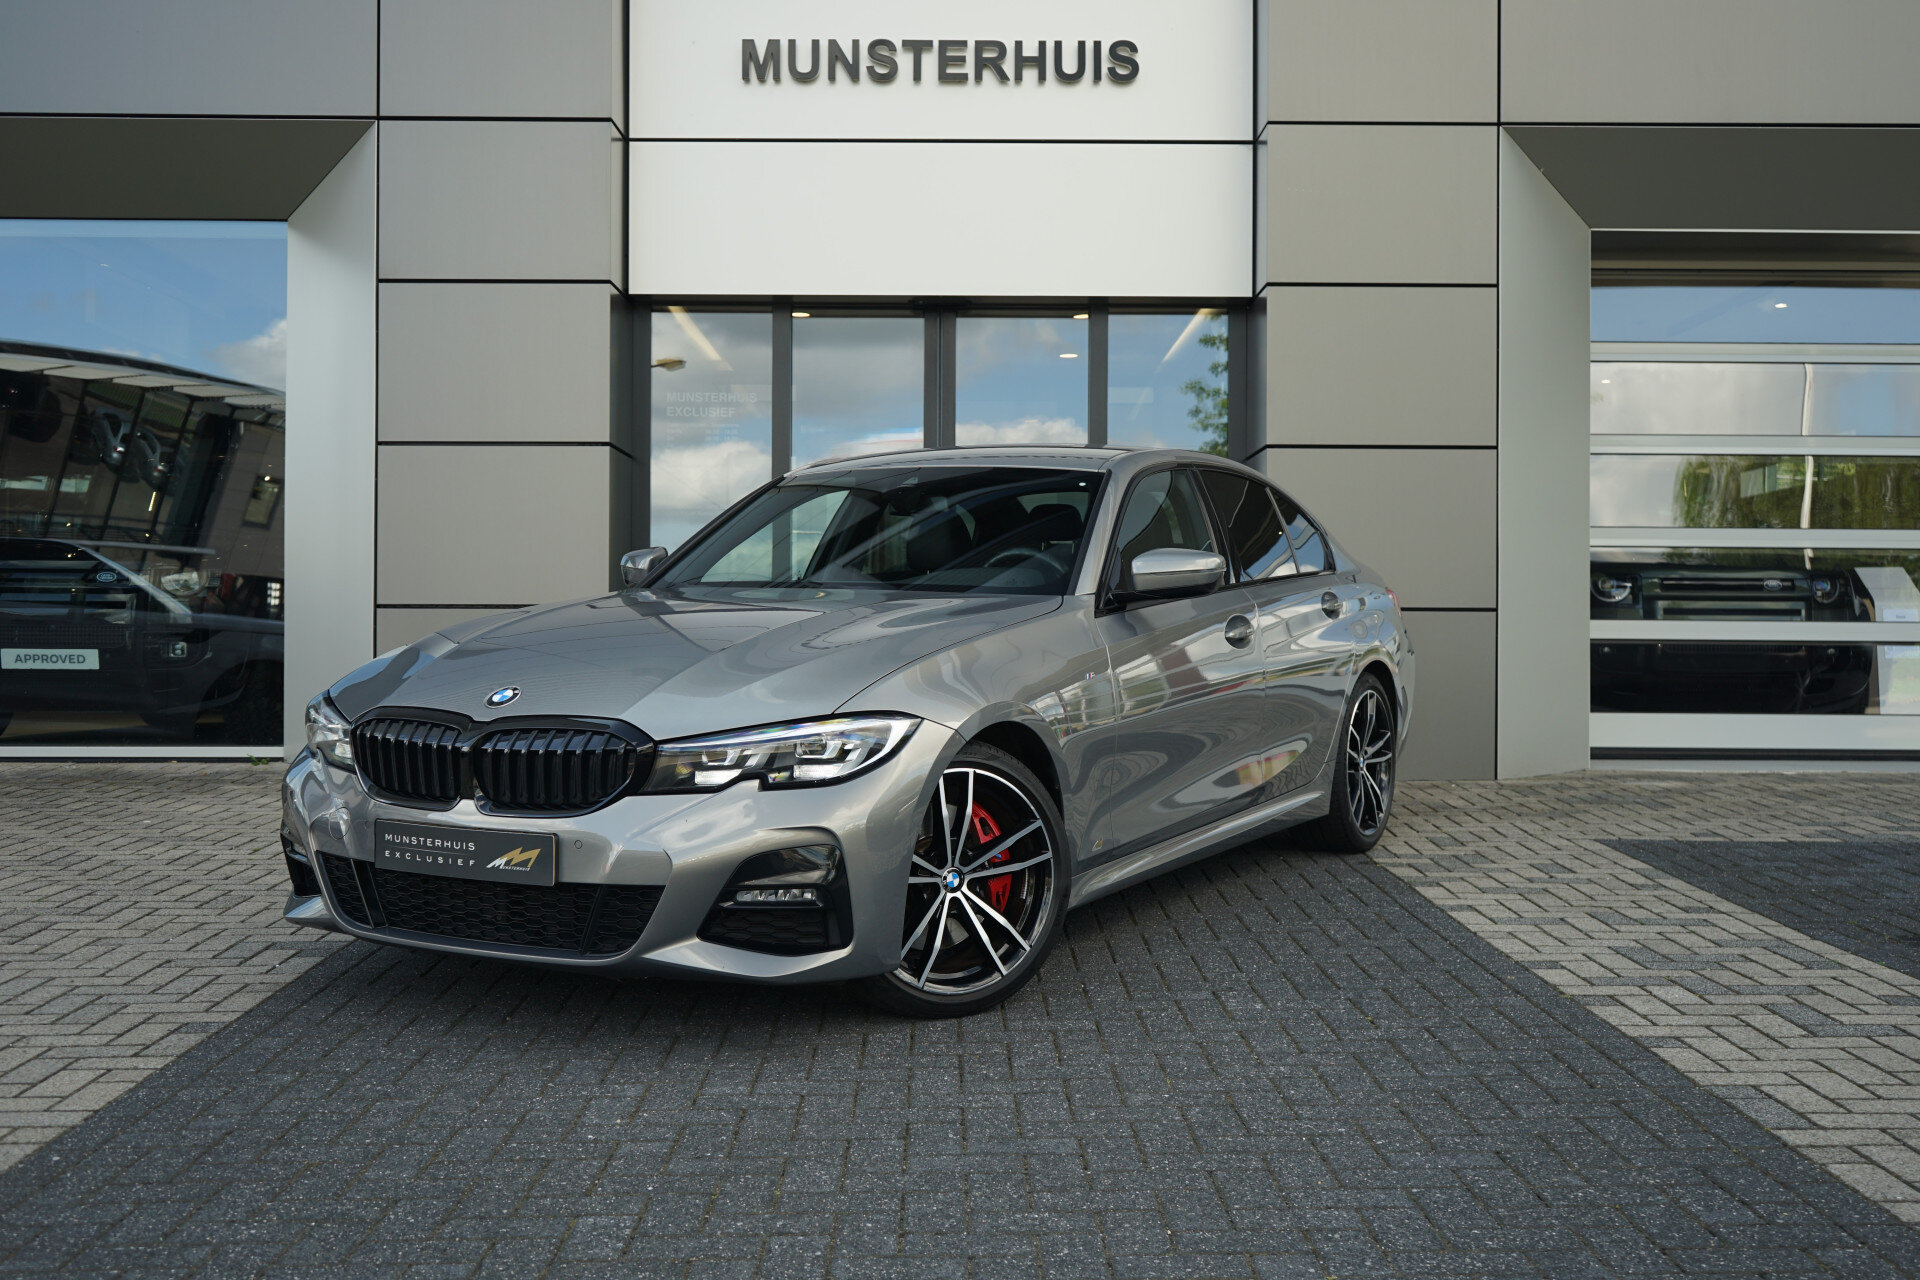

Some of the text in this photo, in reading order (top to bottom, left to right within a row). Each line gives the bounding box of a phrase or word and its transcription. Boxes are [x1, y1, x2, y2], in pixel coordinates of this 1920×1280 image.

[741, 38, 1140, 83] MUNSTERHUIS
[666, 391, 758, 403] MUNSTERHUIS
[666, 406, 736, 417] EXCLUSIEF
[14, 654, 86, 664] APPROVED
[385, 833, 475, 850] MUNSTERHUIS
[385, 850, 476, 867] EXCLUSIEF
